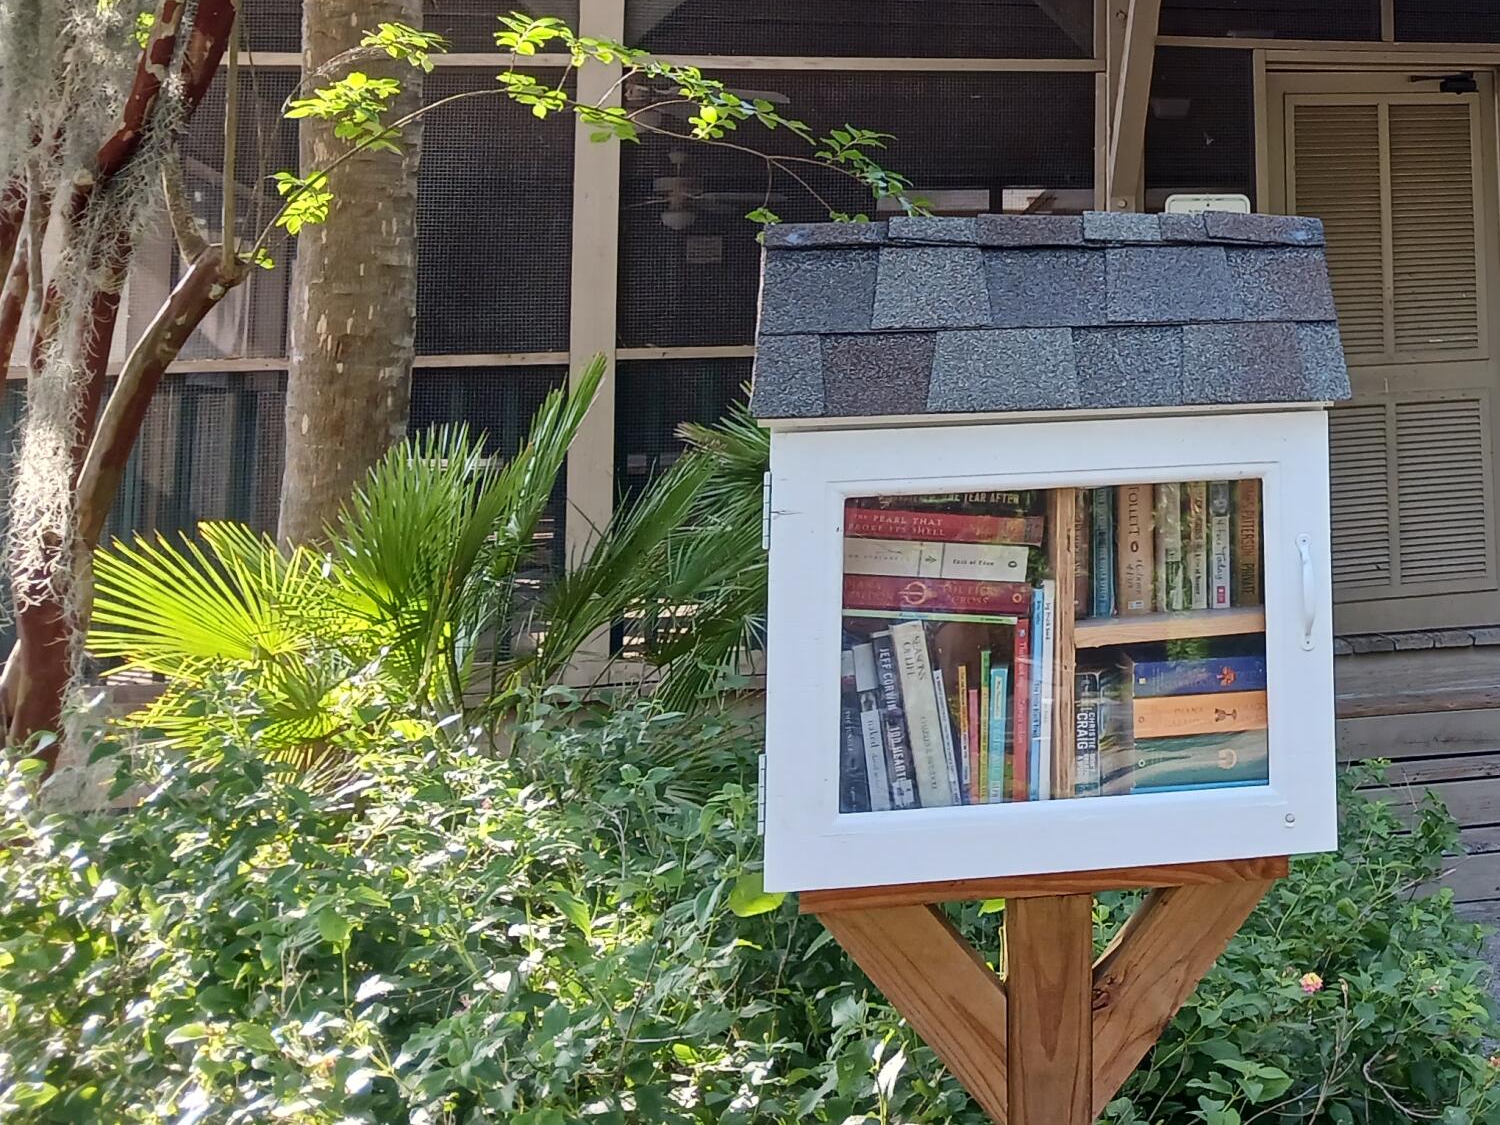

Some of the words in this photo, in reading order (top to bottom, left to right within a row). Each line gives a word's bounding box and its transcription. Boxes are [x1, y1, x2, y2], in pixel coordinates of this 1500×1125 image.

[989, 493, 1020, 504] AFTER
[1127, 486, 1140, 536] FOLLETT
[872, 515, 907, 524] PEARL
[912, 517, 944, 526] THAT
[912, 526, 946, 536] SHELL
[1240, 509, 1256, 557] PATTERSON
[1240, 562, 1256, 596] PRIVATE
[879, 647, 893, 668] JEFF
[882, 672, 898, 711] CORWIN
[867, 720, 880, 748] naked
[1076, 712, 1088, 750] CRAIG
[1088, 712, 1096, 749] CHRISTIE
